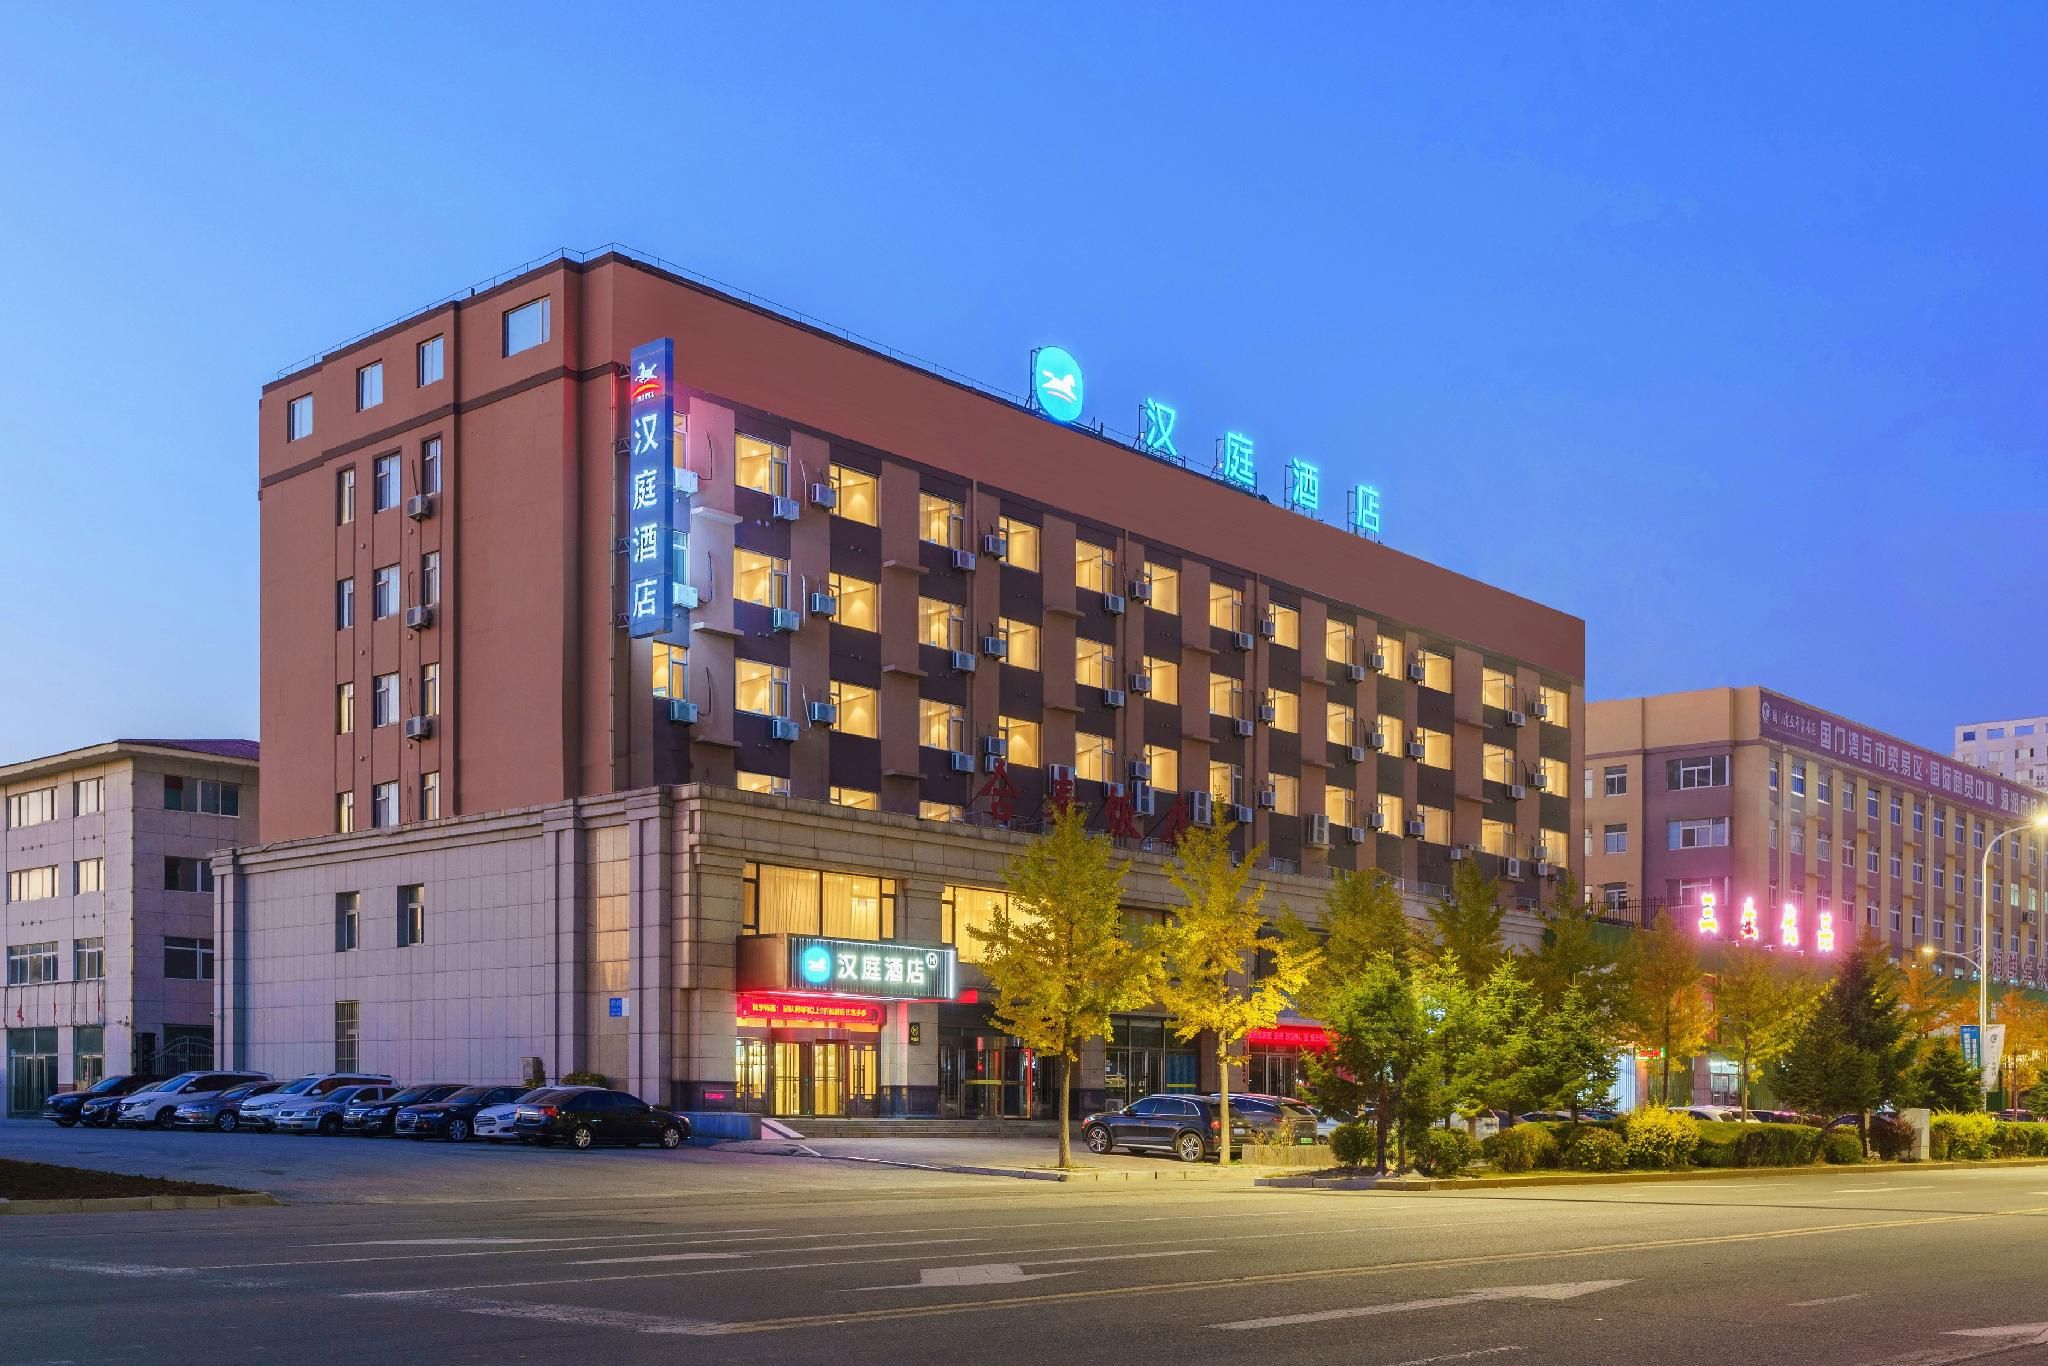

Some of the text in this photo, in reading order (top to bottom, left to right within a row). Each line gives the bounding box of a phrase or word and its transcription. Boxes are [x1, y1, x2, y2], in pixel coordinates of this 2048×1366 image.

[633, 412, 659, 618] 汉庭酒店
[1145, 397, 1380, 533] 汉庭酒店
[837, 952, 926, 984] 汉庭酒店
